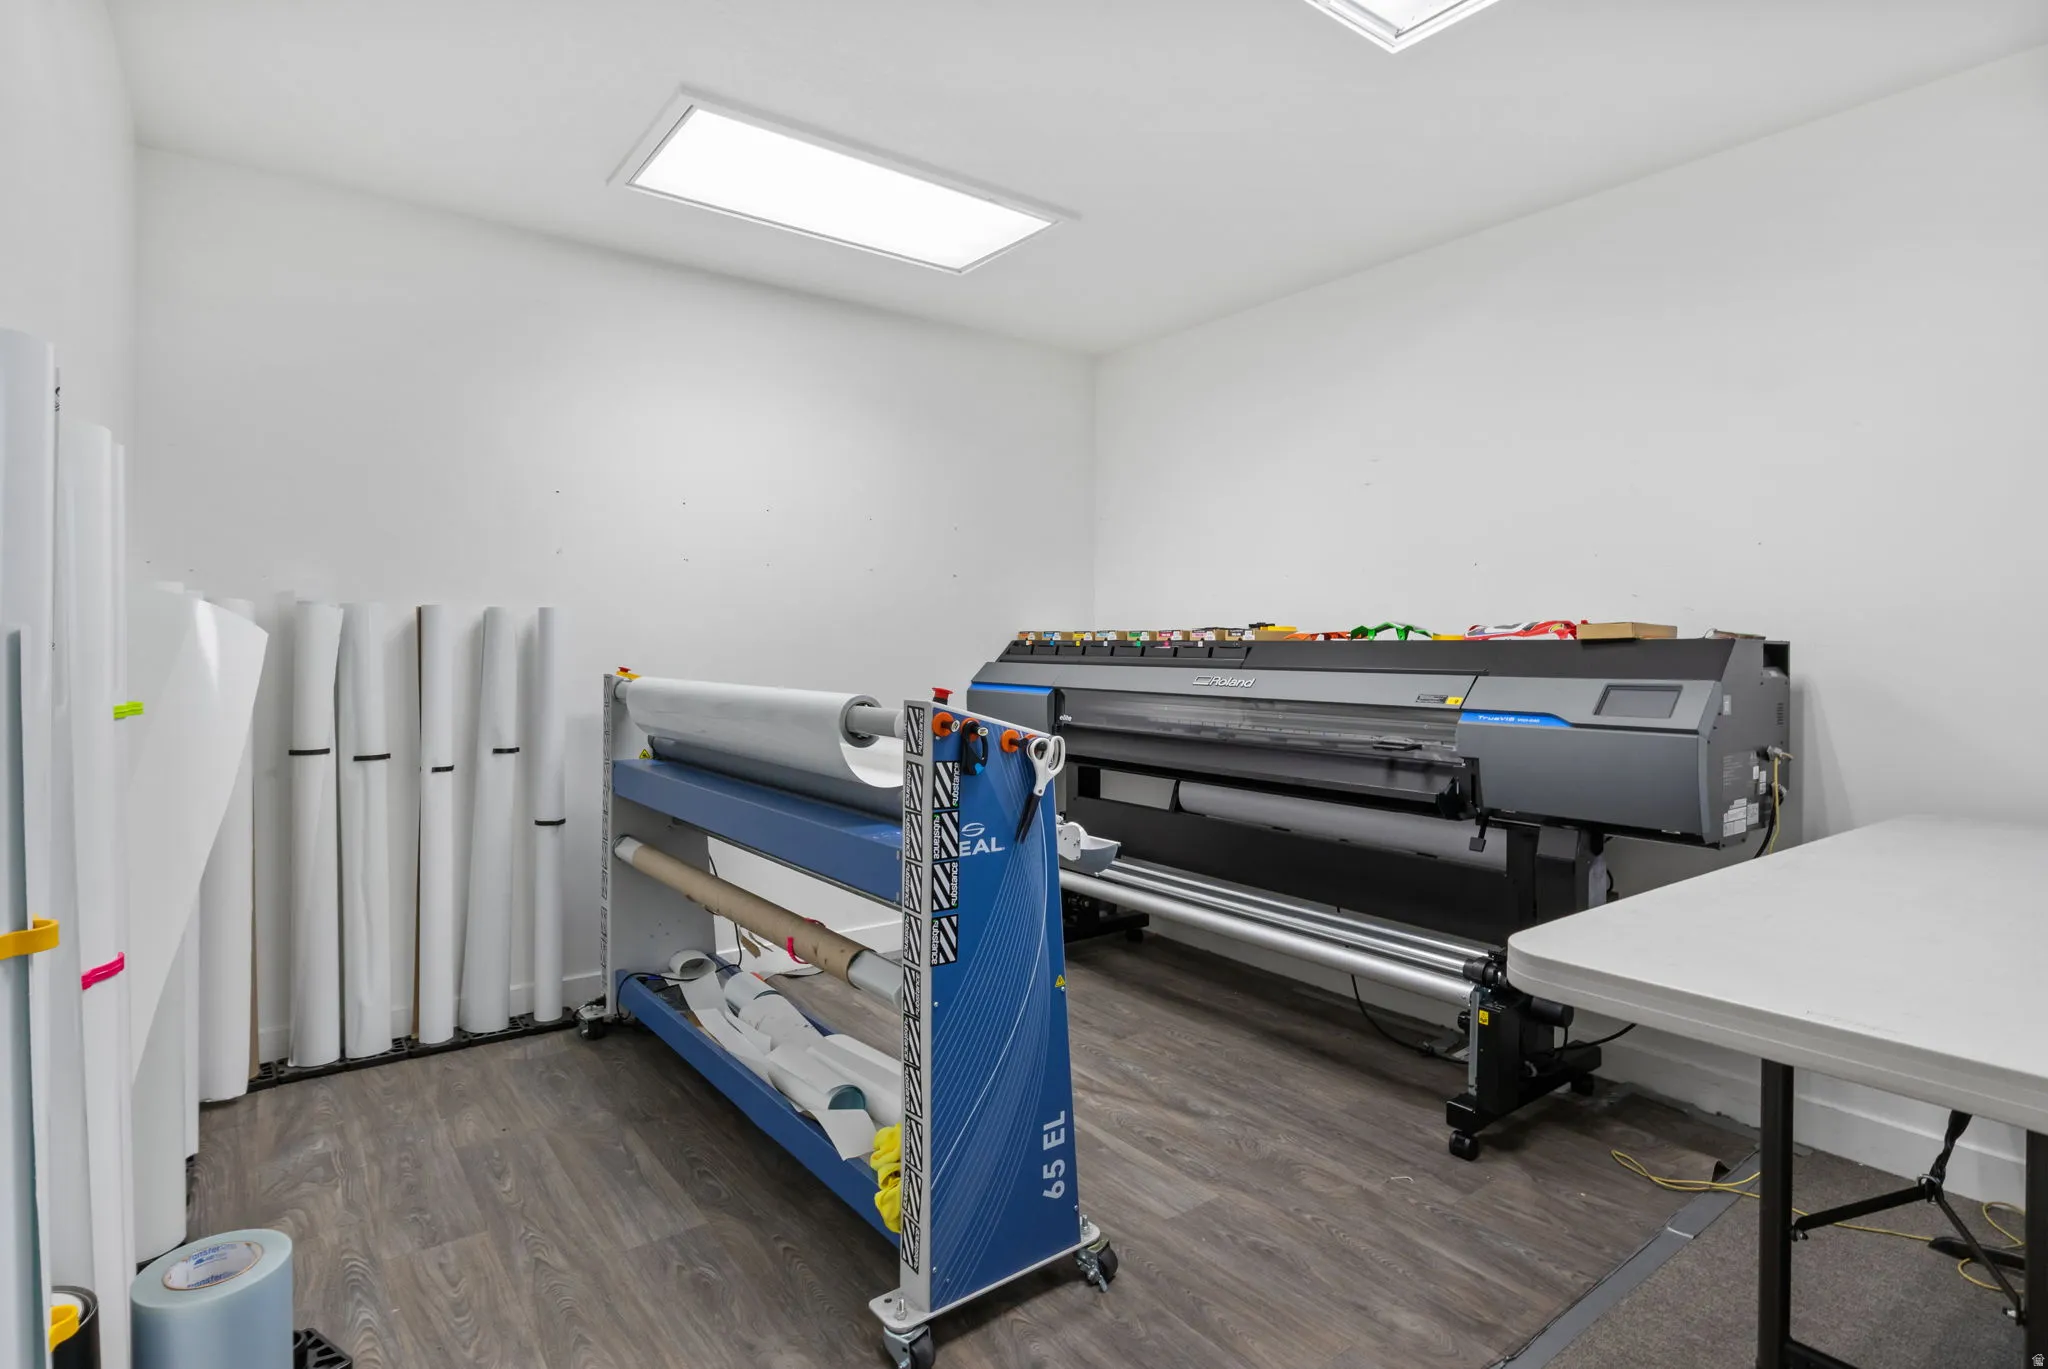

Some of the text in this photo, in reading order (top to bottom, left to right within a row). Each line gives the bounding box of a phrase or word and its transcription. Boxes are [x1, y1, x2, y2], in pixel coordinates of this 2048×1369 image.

[1209, 676, 1257, 689] Roland
[952, 762, 961, 807] substance
[933, 814, 941, 860] substance
[959, 837, 1003, 857] EAL
[951, 862, 959, 907] substance
[931, 919, 940, 965] substance
[1042, 1110, 1066, 1199] 65 EL
